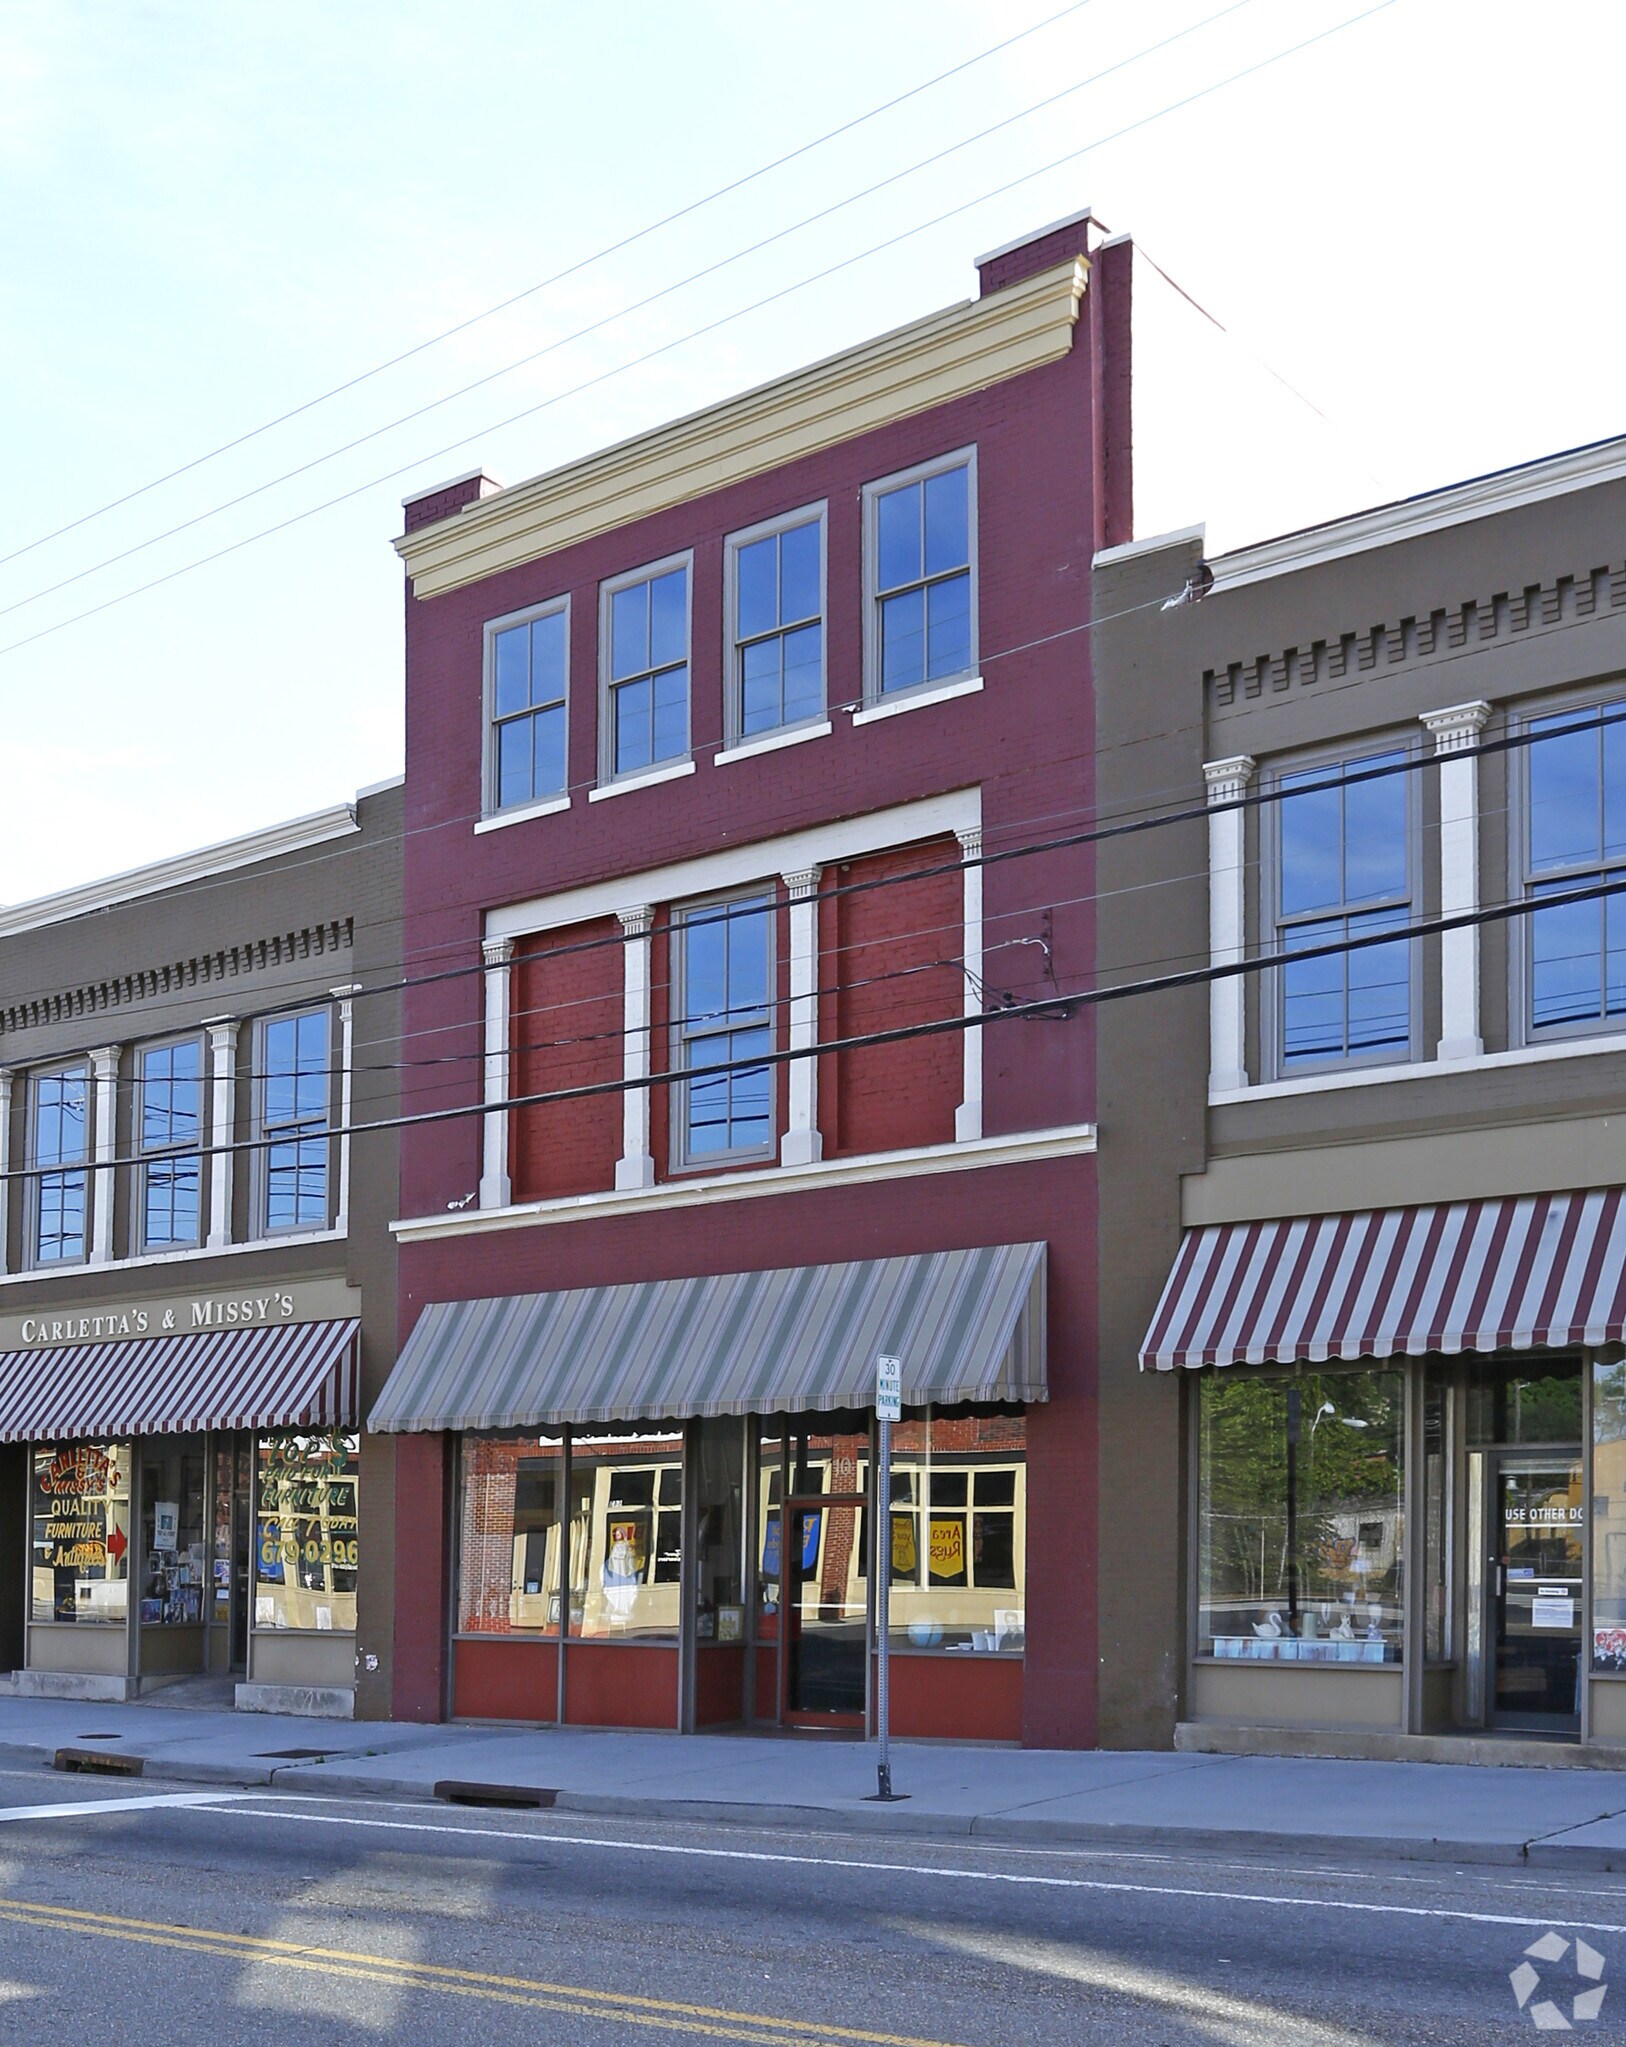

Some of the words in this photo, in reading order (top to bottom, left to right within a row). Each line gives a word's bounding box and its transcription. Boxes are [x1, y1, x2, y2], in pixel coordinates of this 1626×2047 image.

[21, 1309, 149, 1343] CARLETTA'S
[162, 1308, 176, 1329] &
[191, 1293, 295, 1327] MISSY'S
[885, 1363, 896, 1376] 30
[879, 1379, 900, 1393] MINUTE
[878, 1394, 900, 1408] PARKING
[266, 1436, 320, 1466] TOP
[41, 1447, 121, 1494] CARLETTA'S
[262, 1466, 296, 1484] PAID
[299, 1464, 330, 1480] FOR
[54, 1478, 105, 1495] MISSY'S
[261, 1486, 351, 1507] FURNITURE
[51, 1498, 112, 1516] QUALITY
[1505, 1508, 1526, 1520] USE
[1529, 1508, 1566, 1520] OTHER
[45, 1522, 103, 1539] FURNITURE
[262, 1517, 299, 1538] CALL
[300, 1516, 357, 1537] TODAY
[52, 1545, 108, 1574] Antiques
